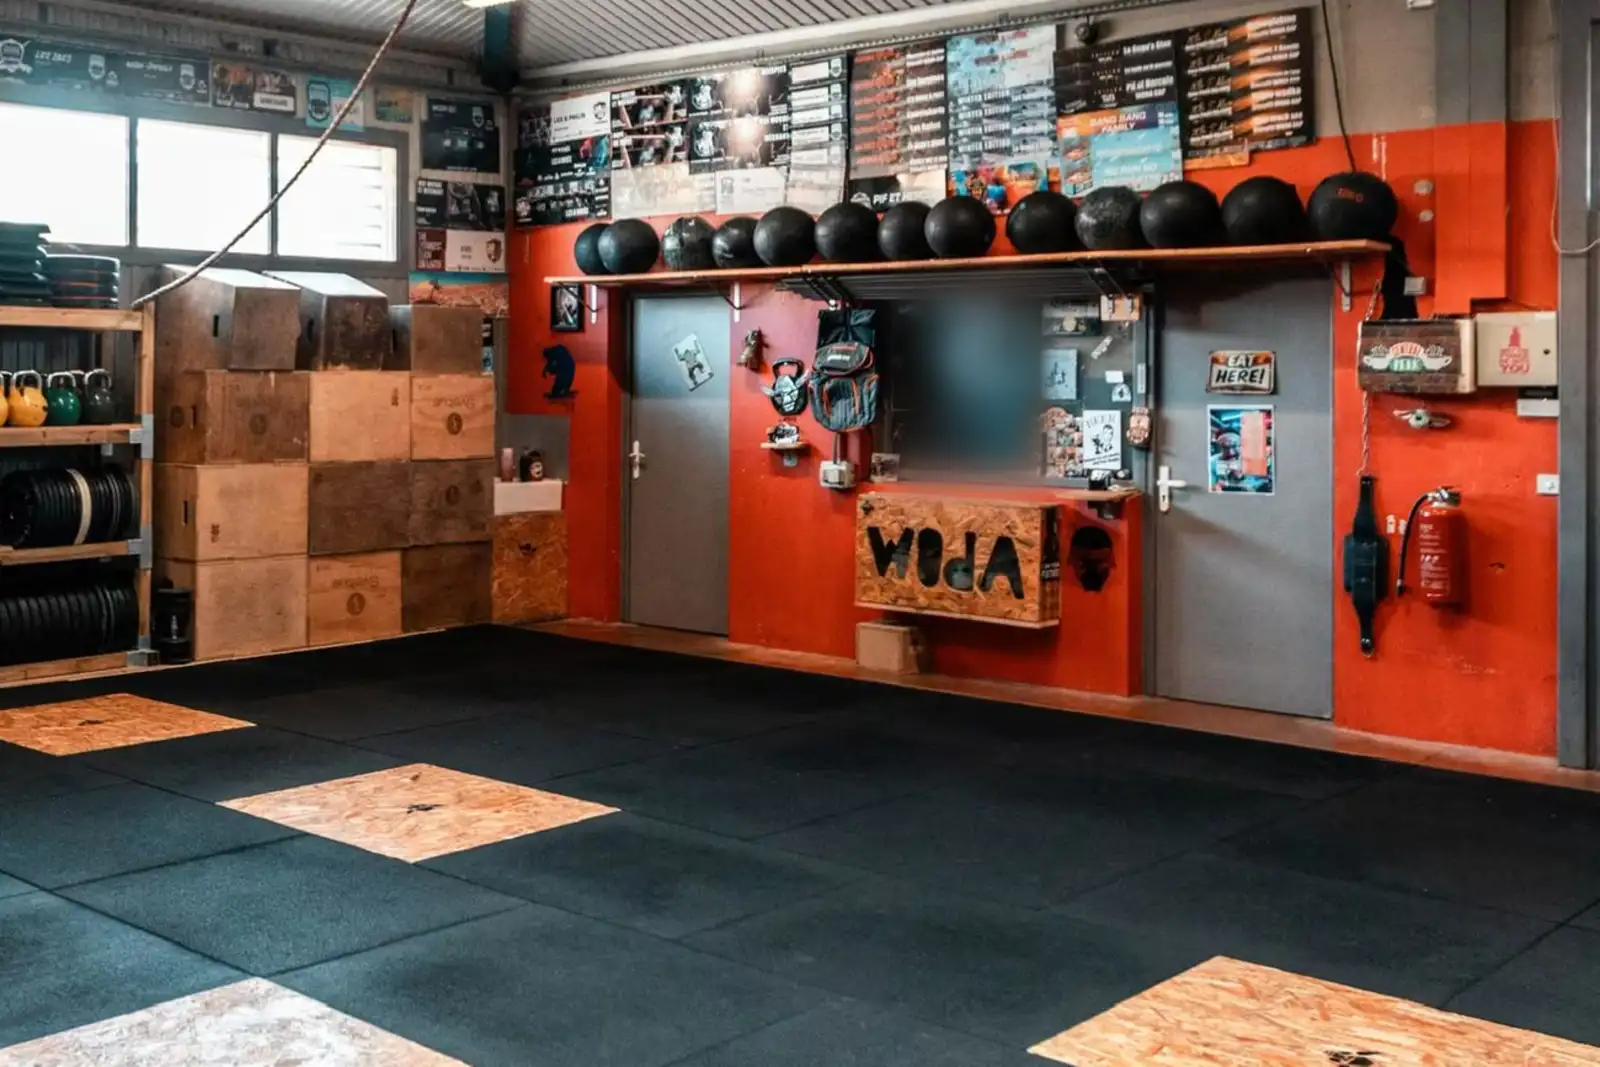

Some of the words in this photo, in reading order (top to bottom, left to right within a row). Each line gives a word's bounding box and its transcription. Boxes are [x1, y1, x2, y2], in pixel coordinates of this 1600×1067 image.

[1119, 111, 1147, 123] BANG
[1102, 122, 1136, 134] FAMILY
[873, 192, 888, 205] PIF
[889, 192, 900, 202] ET
[1227, 354, 1255, 368] EAT
[1215, 368, 1265, 385] HERE!
